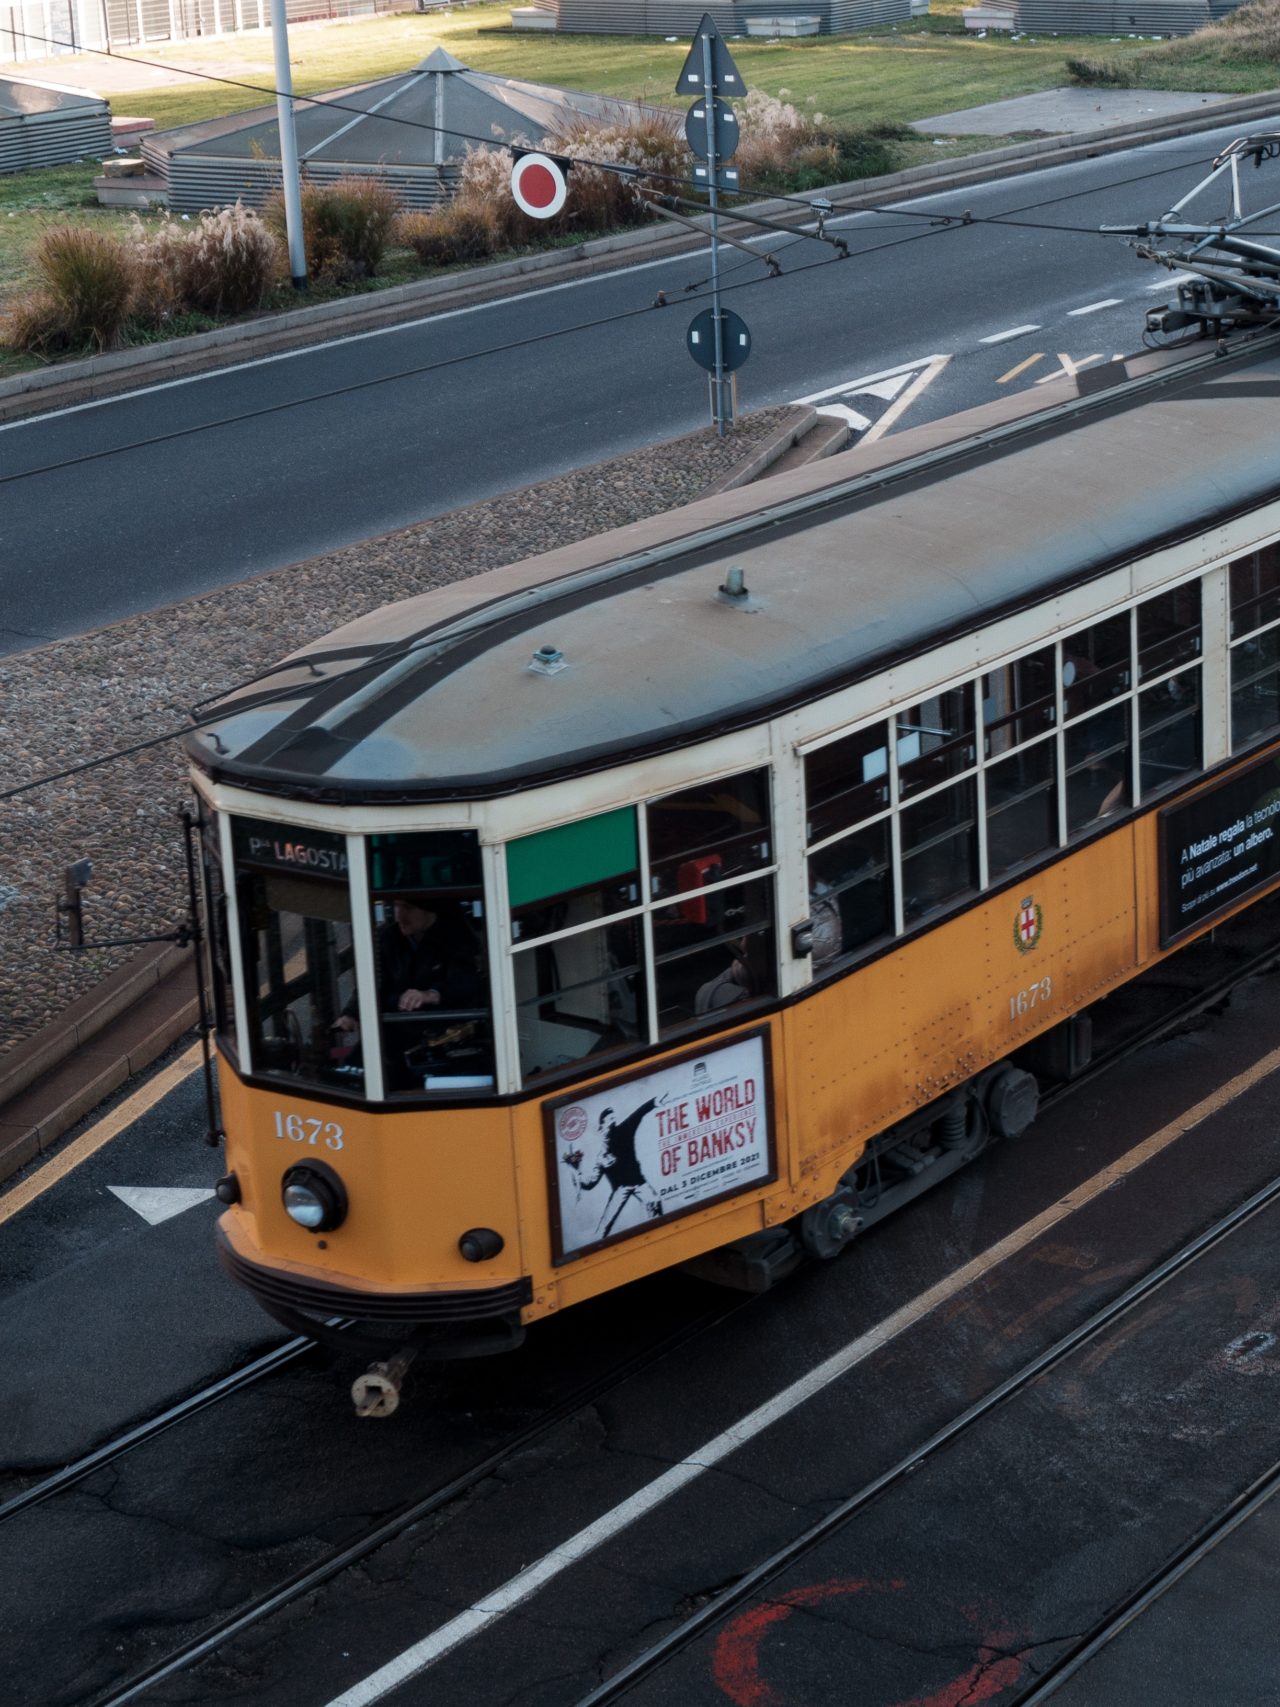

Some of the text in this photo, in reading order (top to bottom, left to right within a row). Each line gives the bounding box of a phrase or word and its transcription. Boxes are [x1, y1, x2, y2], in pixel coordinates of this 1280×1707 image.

[1181, 849, 1189, 864] A
[1189, 835, 1218, 859] Natale
[1218, 819, 1245, 844] regala
[1246, 815, 1254, 828] la
[1181, 867, 1195, 889] più
[1233, 842, 1245, 857] un
[1245, 827, 1274, 850] albero.
[1009, 976, 1051, 1022] 1673
[275, 1111, 344, 1151] 1673
[656, 1102, 689, 1137] THE
[696, 1079, 756, 1122] WORLD
[661, 1146, 682, 1177] OF
[688, 1116, 757, 1168] BANKSY
[660, 1183, 679, 1197] DAL
[690, 1161, 737, 1185] DICEMBRE
[740, 1152, 760, 1166] 2021
